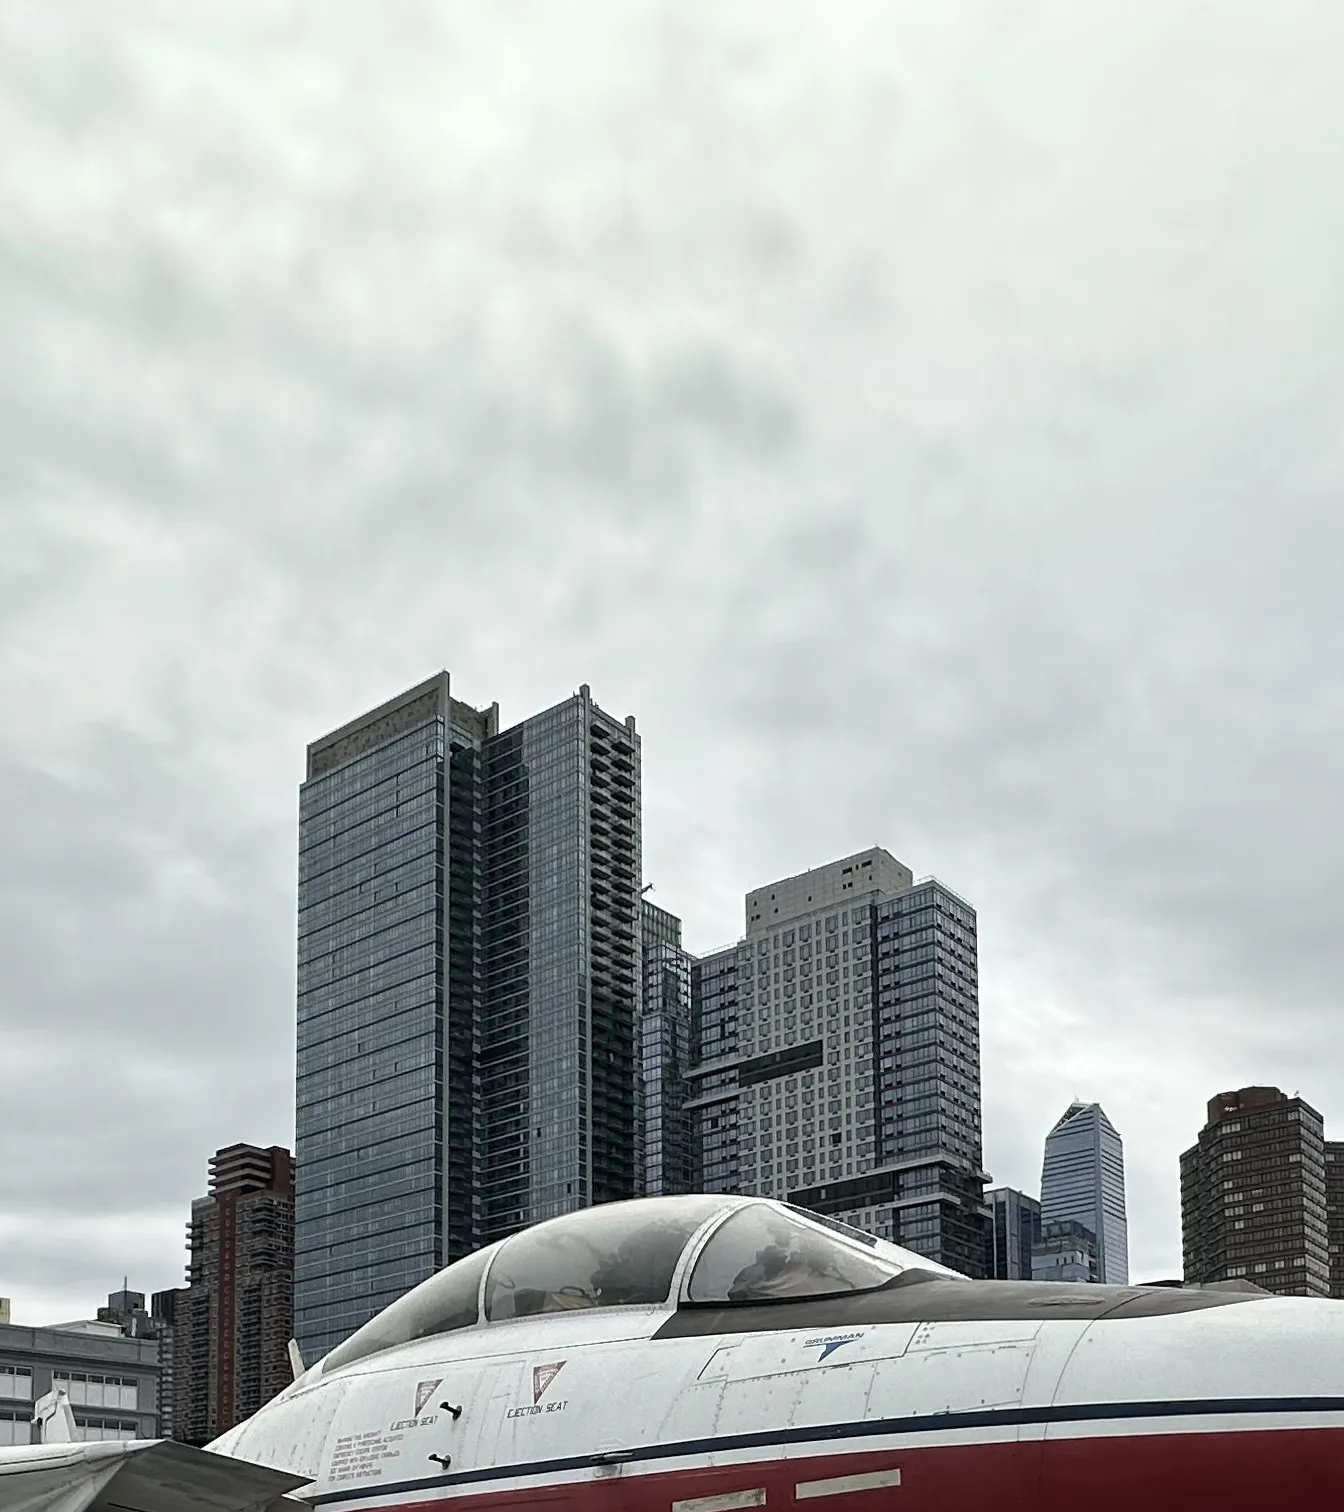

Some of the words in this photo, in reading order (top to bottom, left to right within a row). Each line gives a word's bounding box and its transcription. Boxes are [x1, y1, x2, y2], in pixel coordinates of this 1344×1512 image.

[804, 1332, 865, 1345] GRUMMAN
[507, 1404, 543, 1419] EJECTION
[545, 1401, 568, 1414] SEAT
[390, 1417, 418, 1432] EJECTION
[420, 1415, 439, 1427] SEAT
